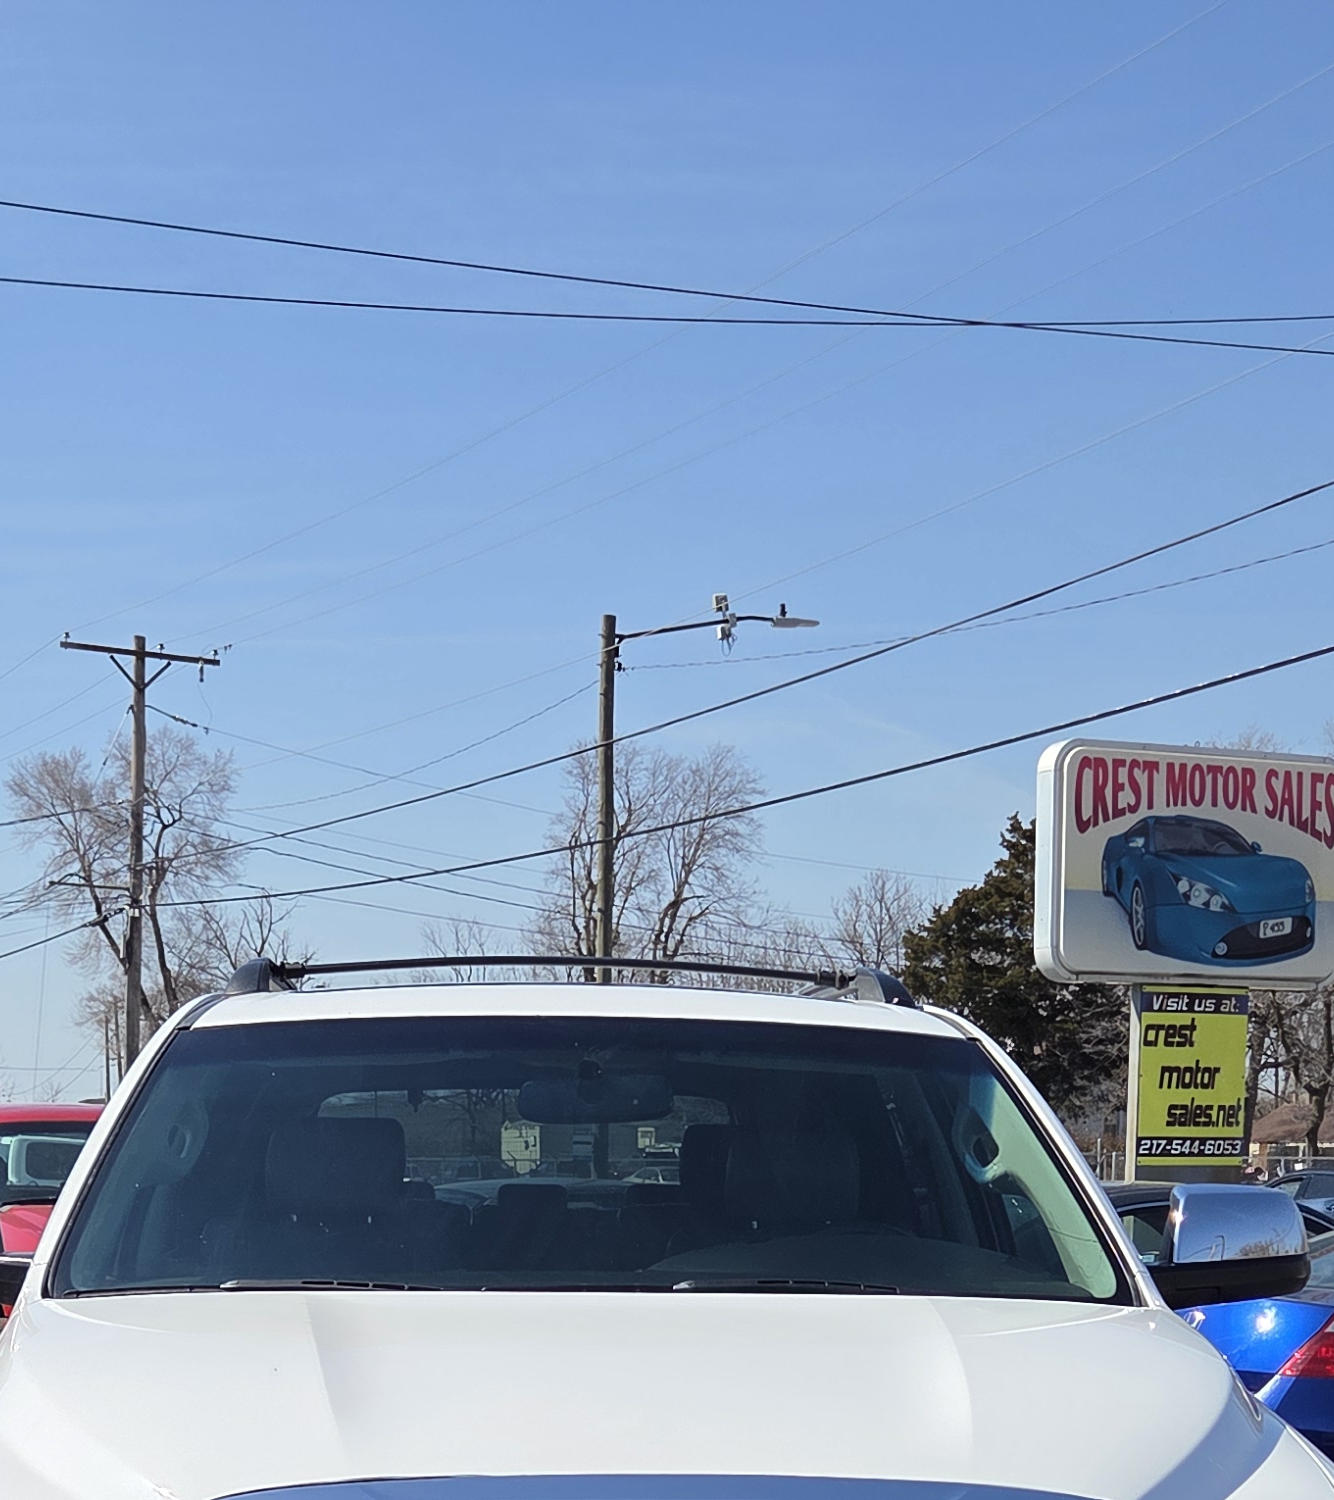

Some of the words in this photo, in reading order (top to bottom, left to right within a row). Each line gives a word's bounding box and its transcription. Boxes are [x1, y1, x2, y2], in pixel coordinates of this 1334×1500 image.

[1074, 756, 1159, 834] CREST
[1166, 761, 1258, 814] MOTOR
[1152, 995, 1188, 1011] Visit
[1194, 998, 1216, 1012] us
[1220, 997, 1239, 1012] at:
[1143, 1017, 1197, 1047] crest
[1158, 1059, 1220, 1089] motor
[1165, 1097, 1242, 1127] sales.net
[1139, 1139, 1242, 1155] 217-544-6053
